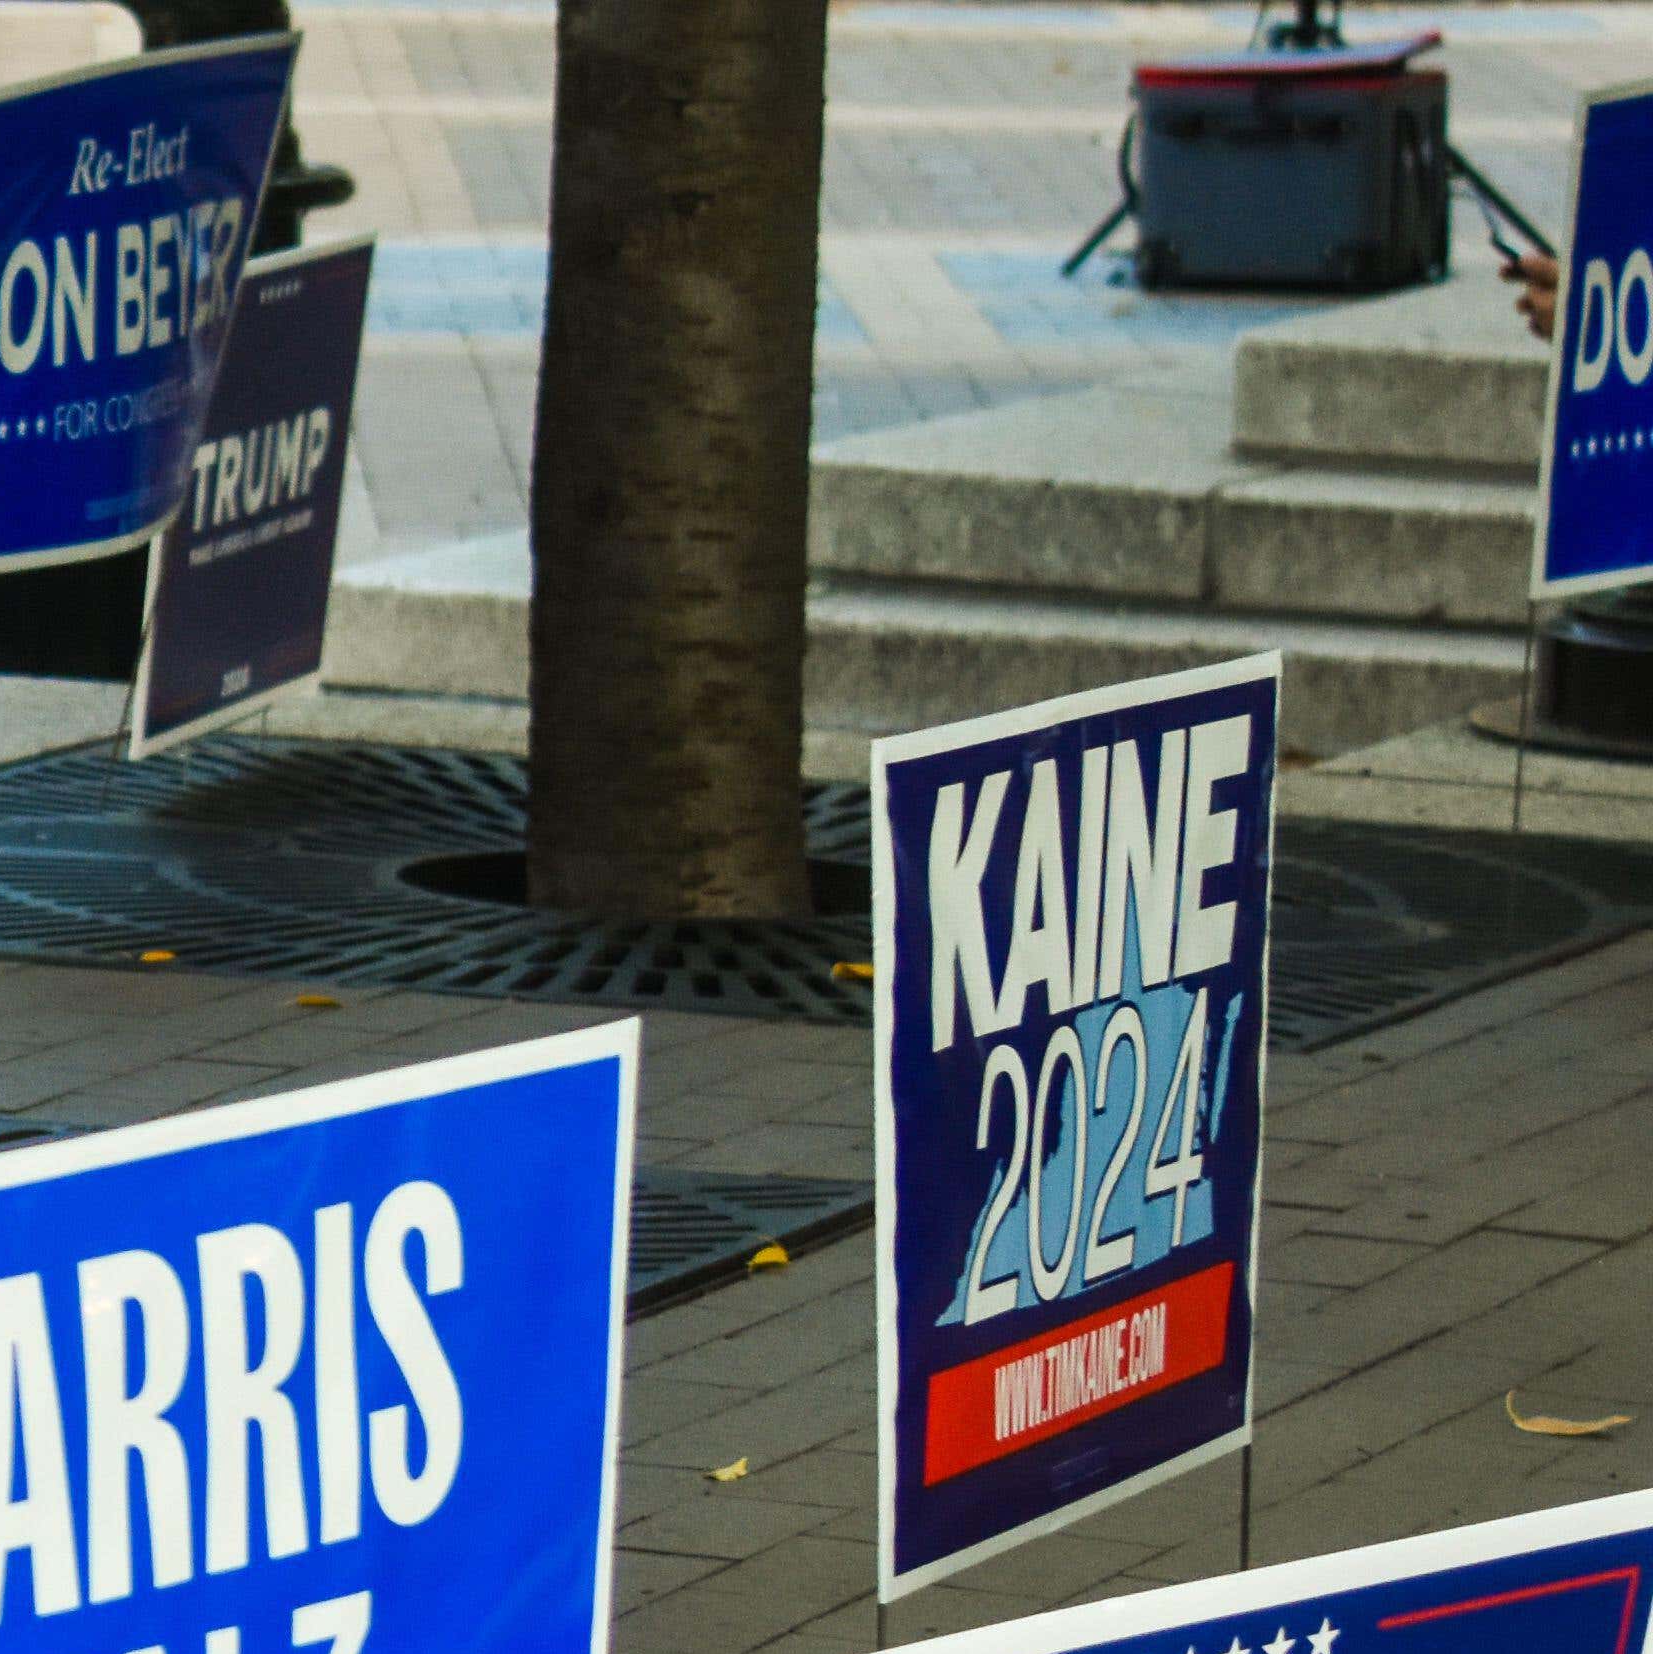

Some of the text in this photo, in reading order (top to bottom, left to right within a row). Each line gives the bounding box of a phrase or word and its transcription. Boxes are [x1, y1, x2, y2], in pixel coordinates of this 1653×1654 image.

[68, 122, 189, 197] Re-Elect
[116, 199, 244, 357] BEYER
[1573, 248, 1653, 392] DO
[54, 401, 98, 442] FOR
[193, 408, 331, 533] TRUMP
[928, 713, 1252, 1054] KAINE
[964, 986, 1208, 1327] 2024
[994, 1301, 1168, 1443] WWW.TIMKAINE.COM
